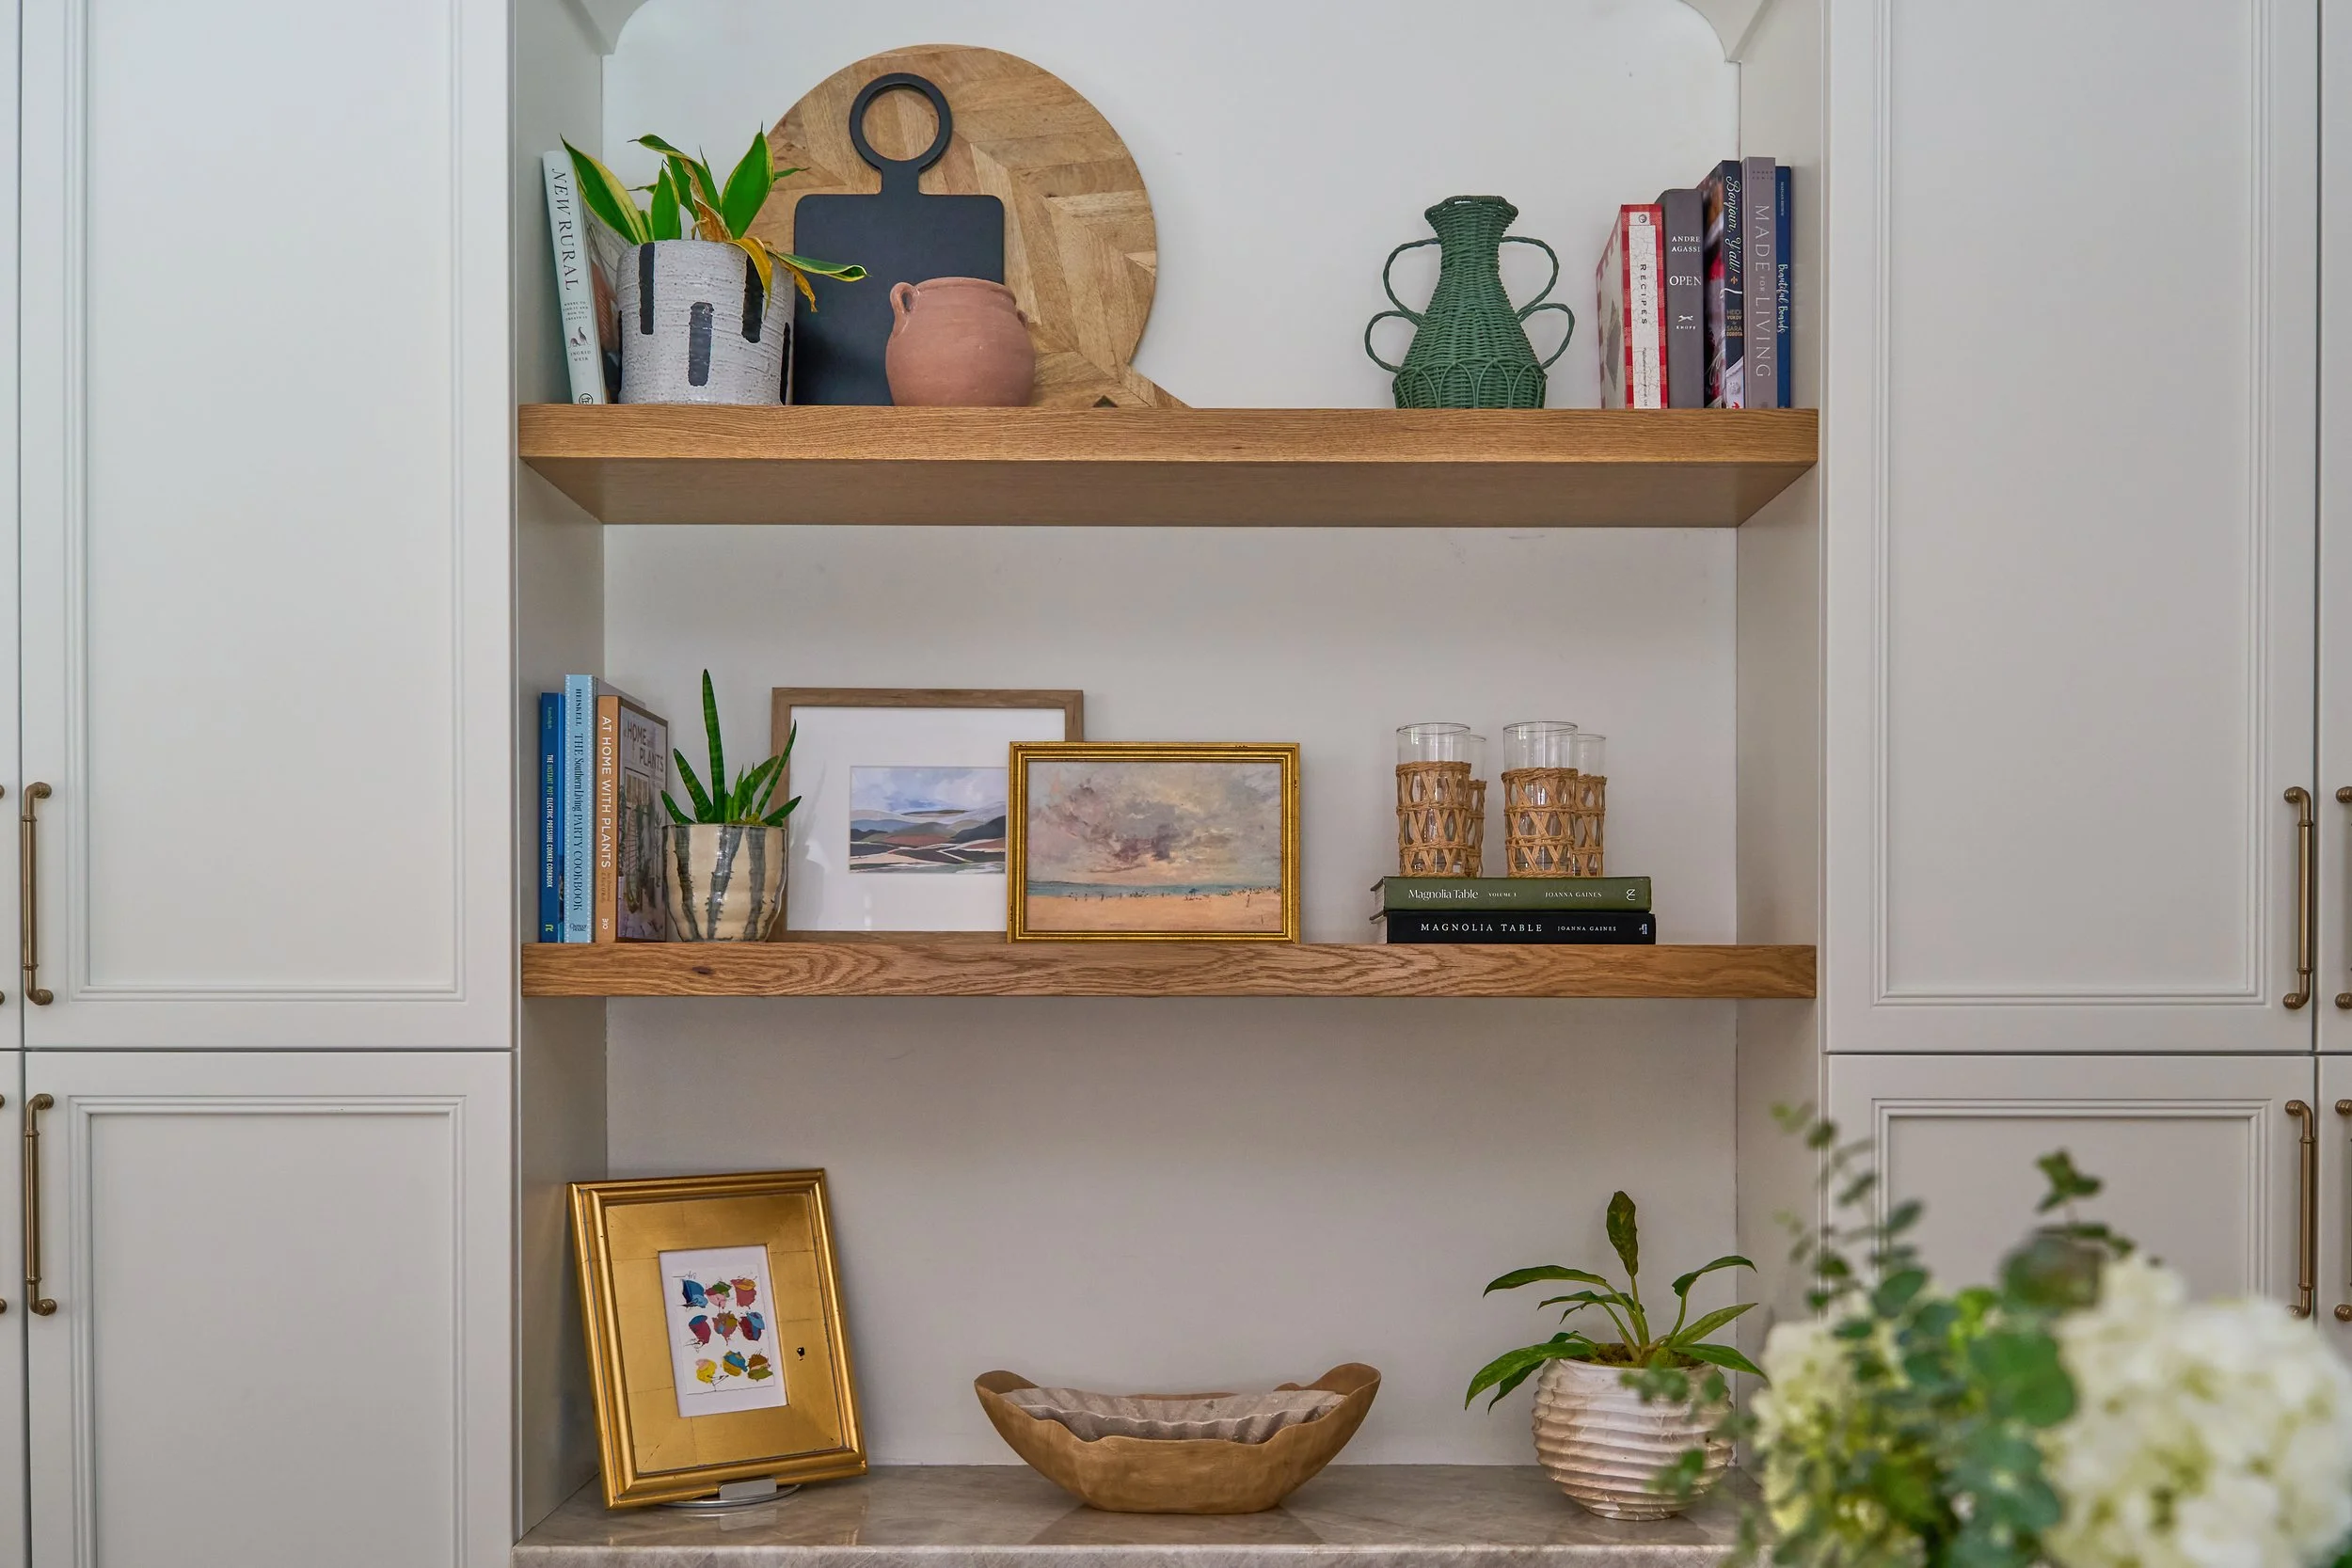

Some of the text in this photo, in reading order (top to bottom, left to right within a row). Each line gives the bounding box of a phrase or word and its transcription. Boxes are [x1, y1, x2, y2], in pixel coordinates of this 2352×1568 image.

[551, 167, 580, 292] NEW RURAL
[1724, 176, 1741, 274] Bonjour, Y'all!
[1755, 205, 1771, 272] MADE
[1669, 275, 1702, 286] OPEN
[1776, 263, 1788, 334] Beautiful Boards
[1756, 296, 1771, 377] LIVING
[628, 721, 647, 746] HOME
[639, 747, 664, 772] PLANTS
[546, 765, 554, 784] INSTANT
[601, 716, 612, 868] AT HOME WITH PLANTS
[572, 733, 584, 911] THE Southern Living PARTY COOKBOOK
[1408, 889, 1452, 900] Magnolia
[1453, 889, 1479, 899] Table
[1501, 924, 1542, 932] TABLE
